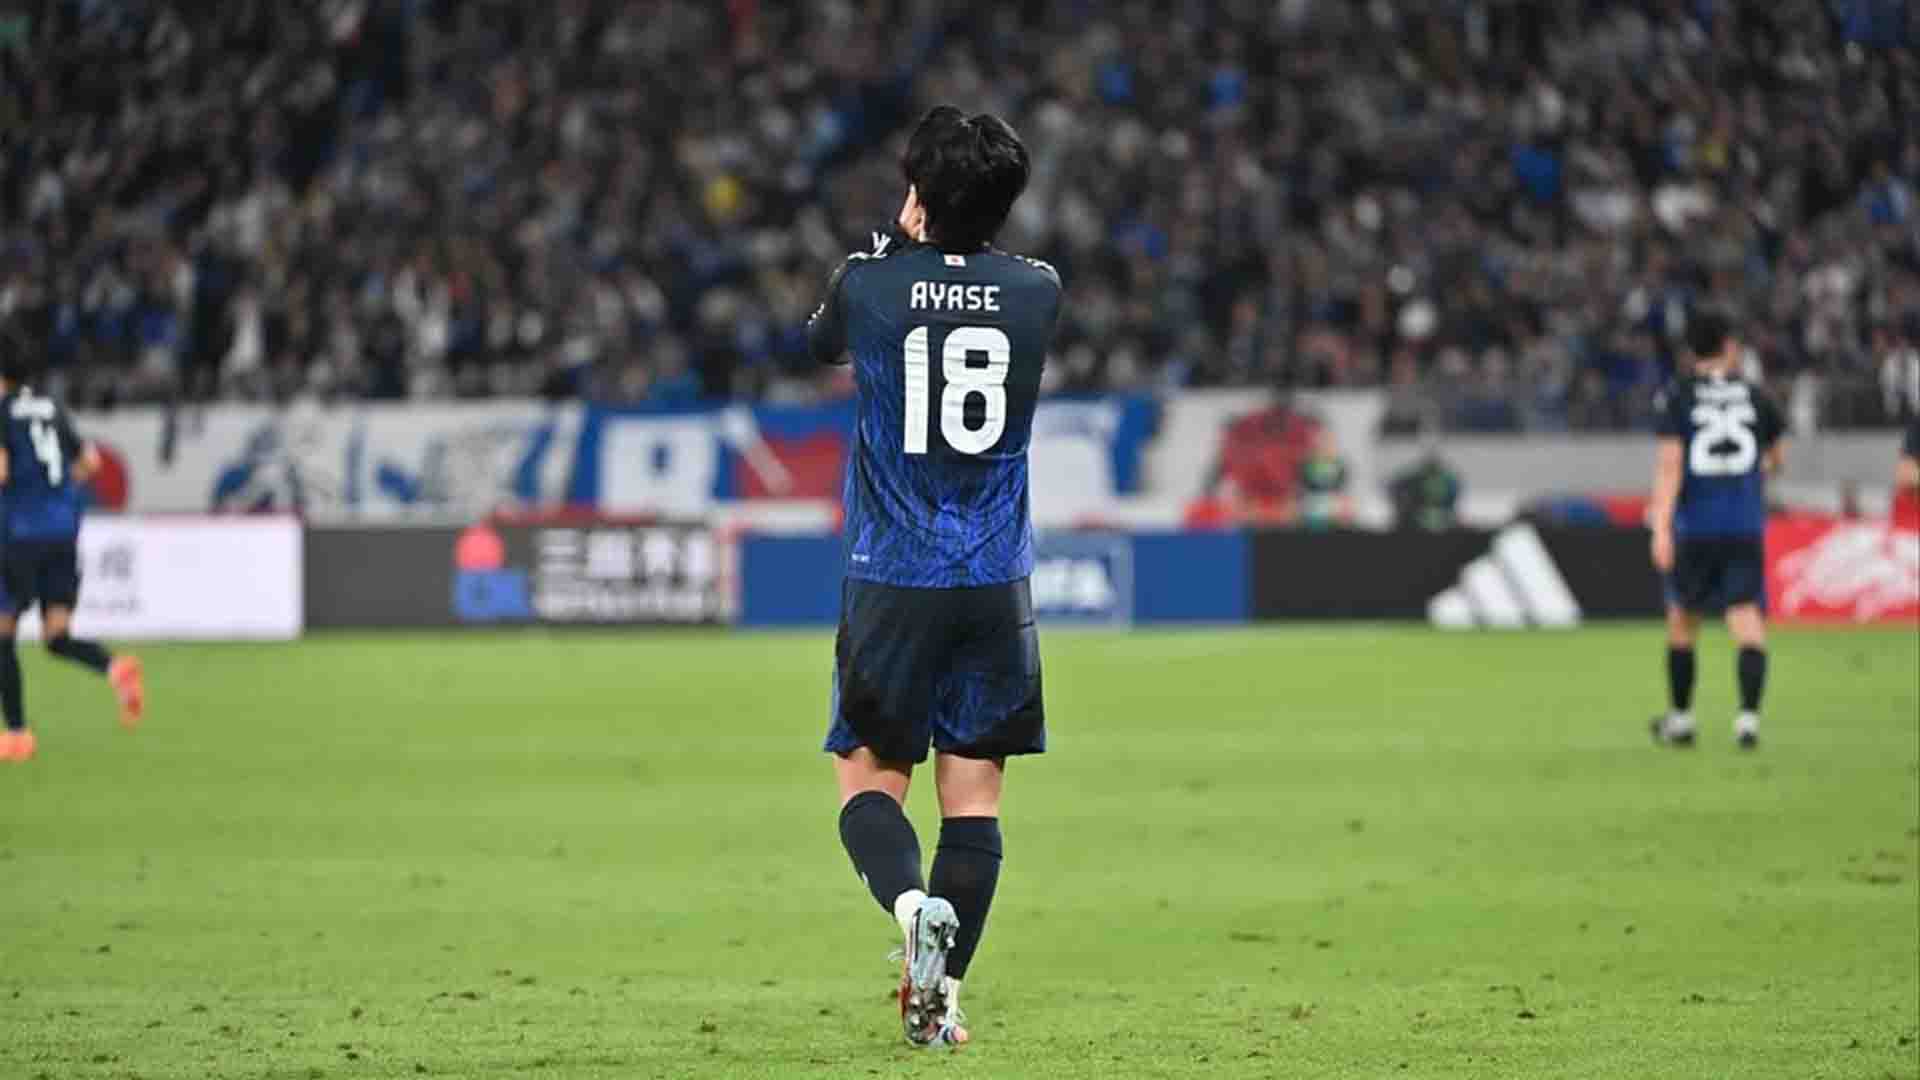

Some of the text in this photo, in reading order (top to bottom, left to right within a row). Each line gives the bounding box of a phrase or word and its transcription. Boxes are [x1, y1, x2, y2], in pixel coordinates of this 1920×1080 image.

[910, 281, 1001, 311] AYASE
[903, 326, 1011, 455] 18
[30, 418, 63, 487] 4
[1690, 403, 1757, 475] 25
